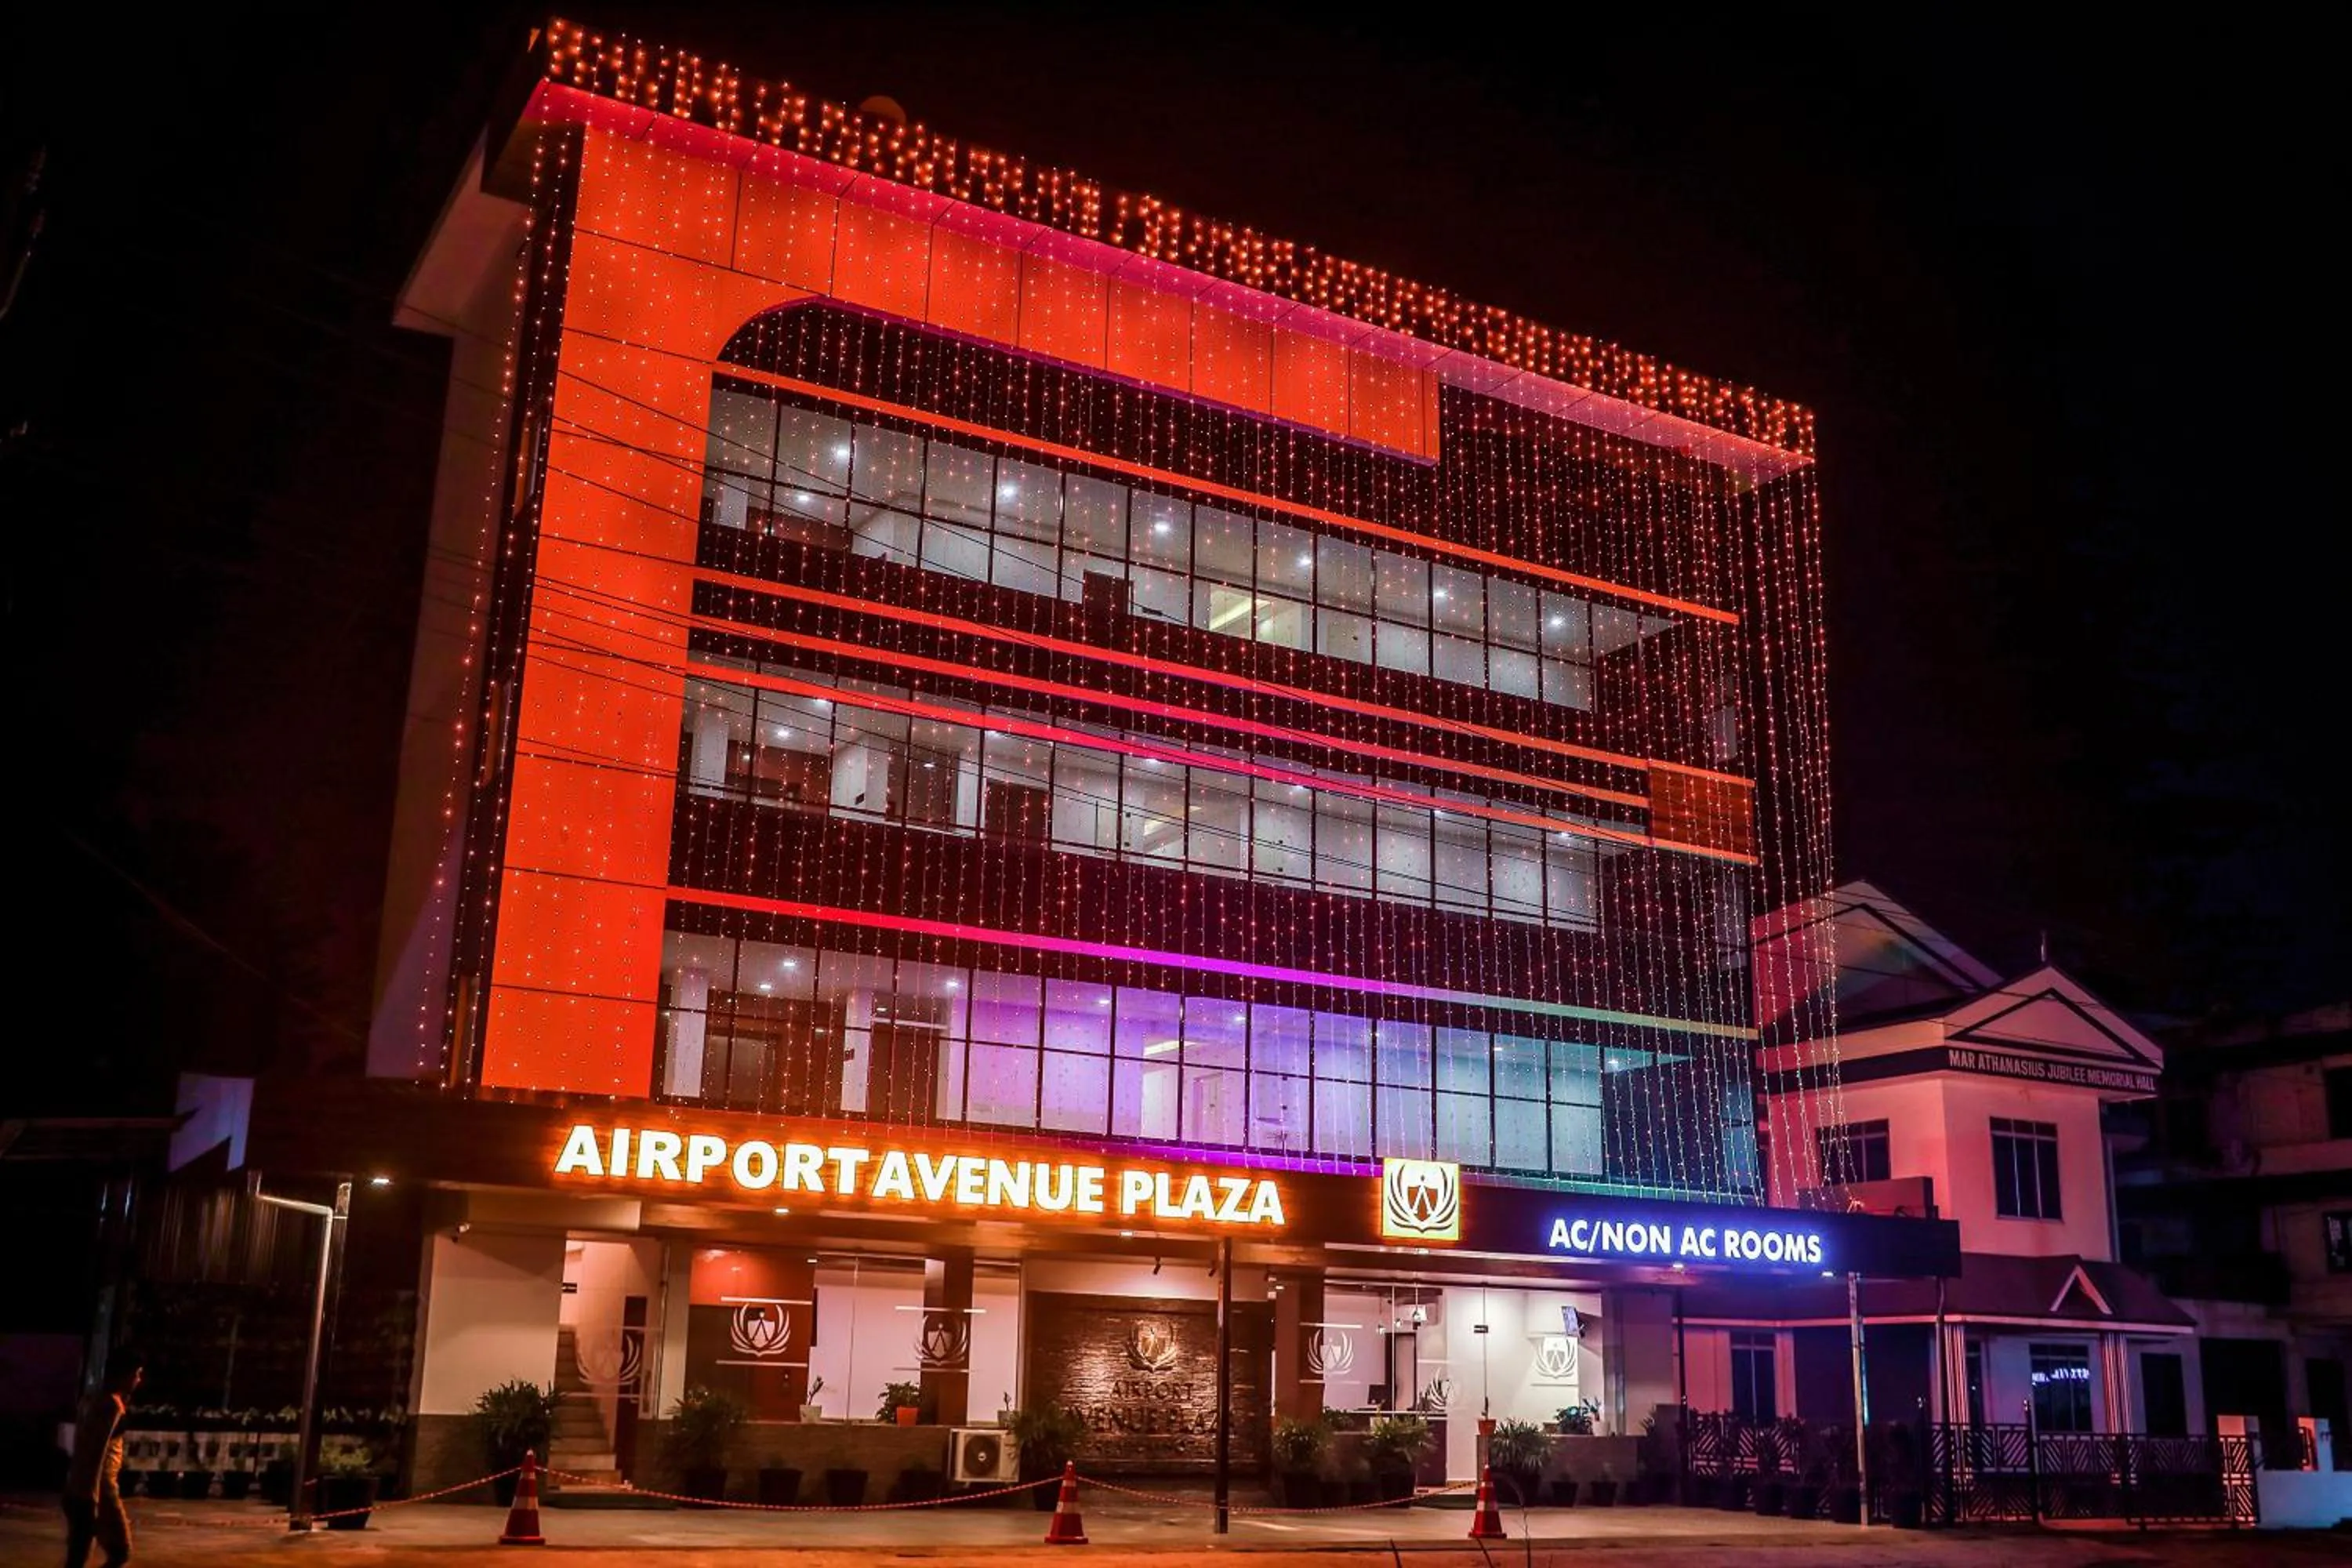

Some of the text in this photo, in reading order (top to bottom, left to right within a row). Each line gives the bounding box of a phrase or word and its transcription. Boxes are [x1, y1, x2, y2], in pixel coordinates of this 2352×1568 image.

[1948, 1049, 1976, 1069] MAR
[1978, 1053, 2045, 1077] ATHANASIUS
[2047, 1064, 2086, 1083] JUBILEE
[2087, 1069, 2136, 1089] MEMORIAL
[554, 1124, 1286, 1225] AIRPORT AVENUE PLAZA
[1548, 1218, 1823, 1264] AC/NON AC ROOMS
[1110, 1378, 1194, 1400] AIRPORT
